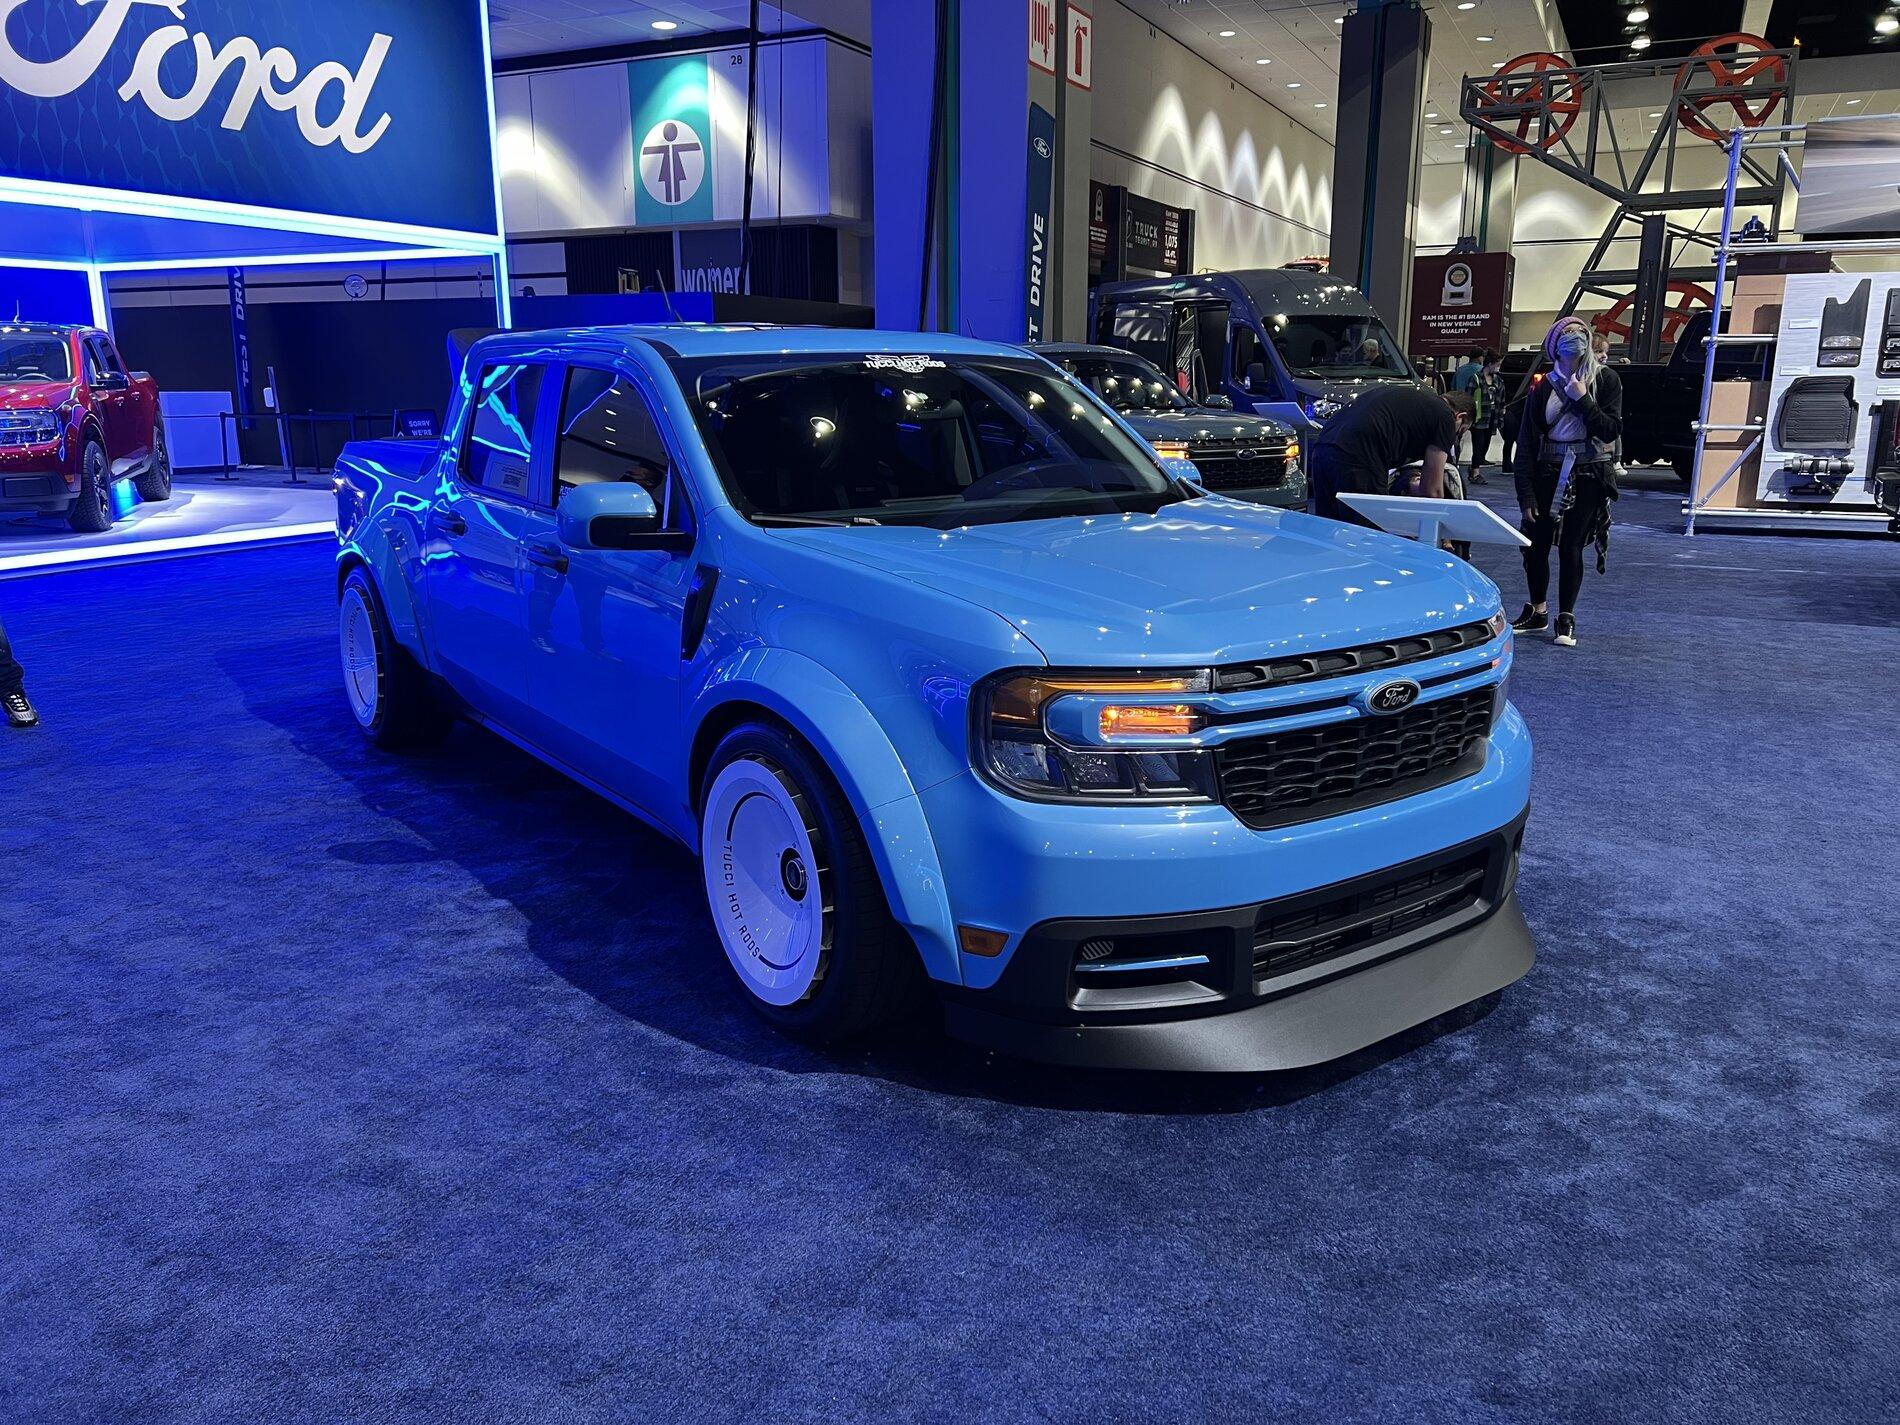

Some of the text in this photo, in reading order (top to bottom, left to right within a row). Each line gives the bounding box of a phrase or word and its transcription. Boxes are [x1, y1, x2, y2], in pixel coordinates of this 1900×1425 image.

[0, 0, 393, 154] Ford
[730, 54, 743, 65] 28
[1135, 221, 1158, 239] TRUCK
[1030, 212, 1044, 307] DRIVE
[1382, 686, 1411, 708] Ford
[723, 845, 760, 958] TUCCI HOT RODS
